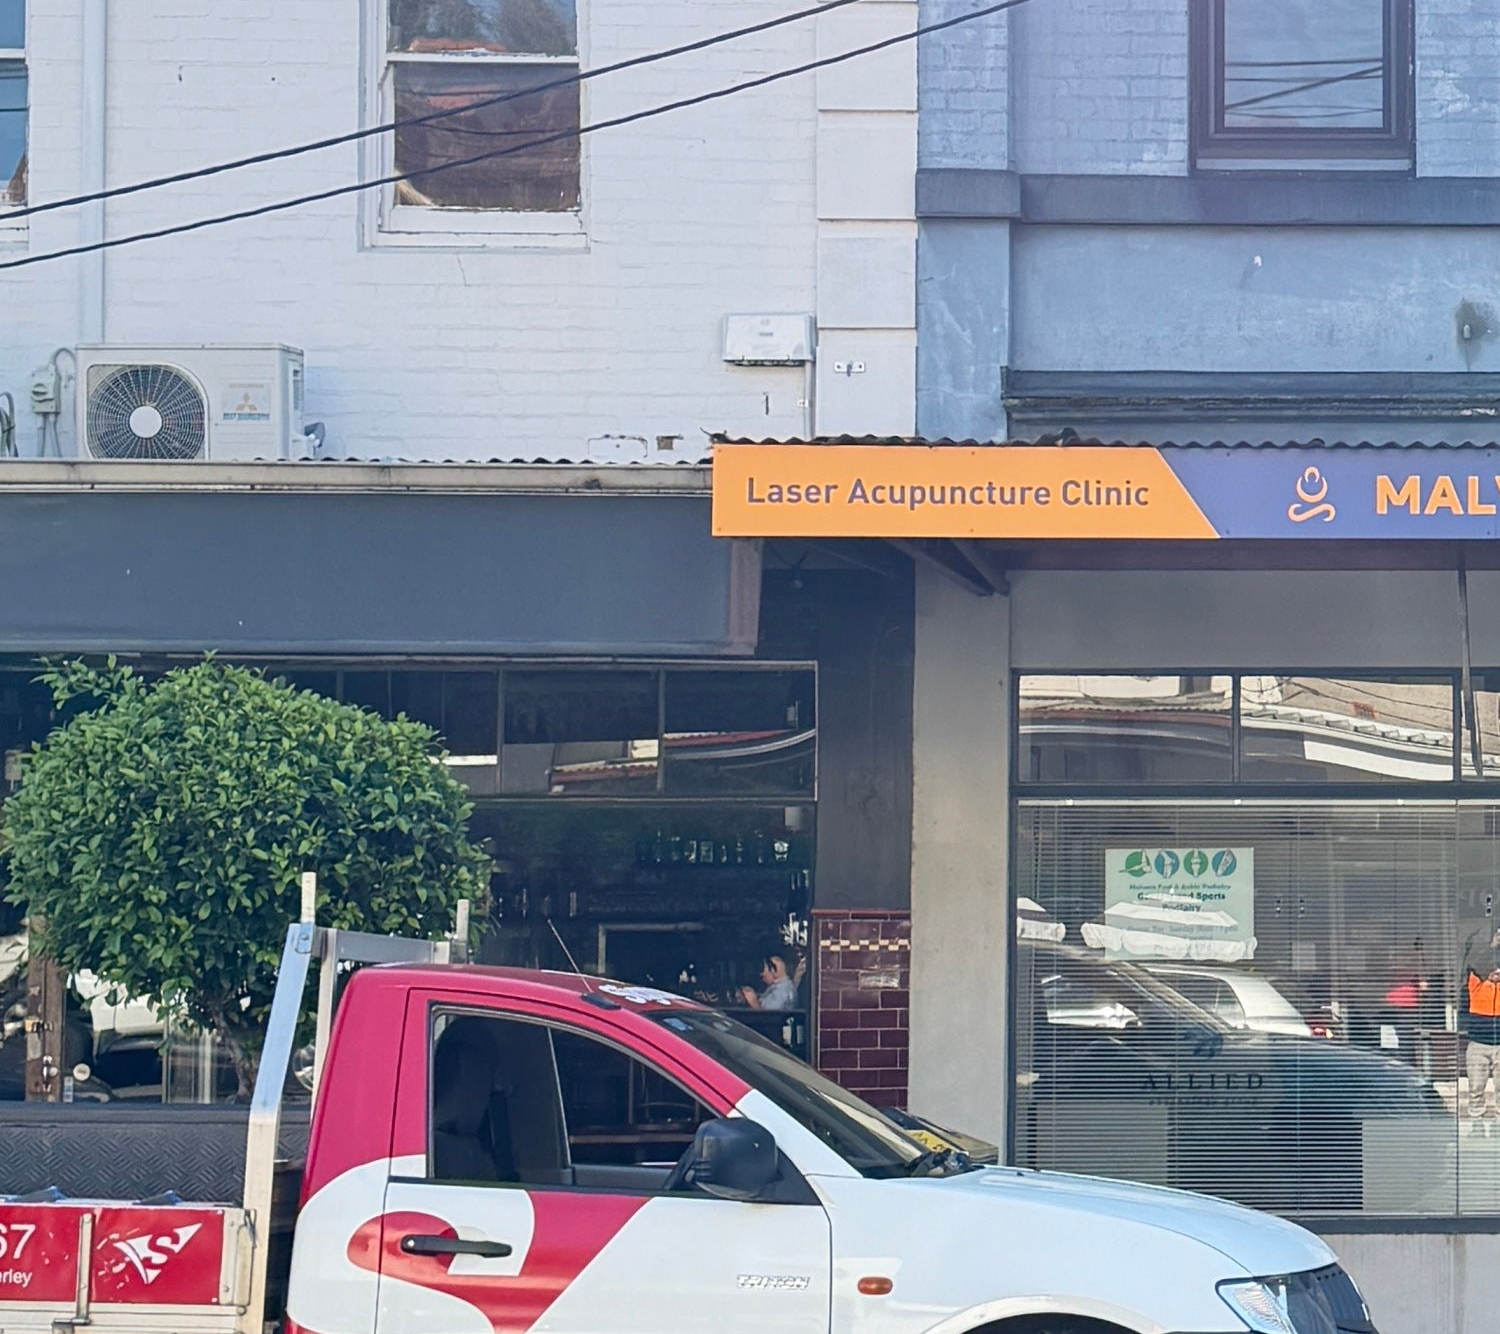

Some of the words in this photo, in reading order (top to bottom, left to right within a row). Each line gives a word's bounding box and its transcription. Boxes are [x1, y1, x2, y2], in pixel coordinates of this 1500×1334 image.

[746, 477, 838, 505] Laser
[847, 478, 1051, 511] Acupuncture
[1061, 479, 1149, 507] Clinic
[1142, 1073, 1264, 1090] ALLIED
[0, 1268, 33, 1289] rley
[736, 1274, 811, 1290] TRITON
